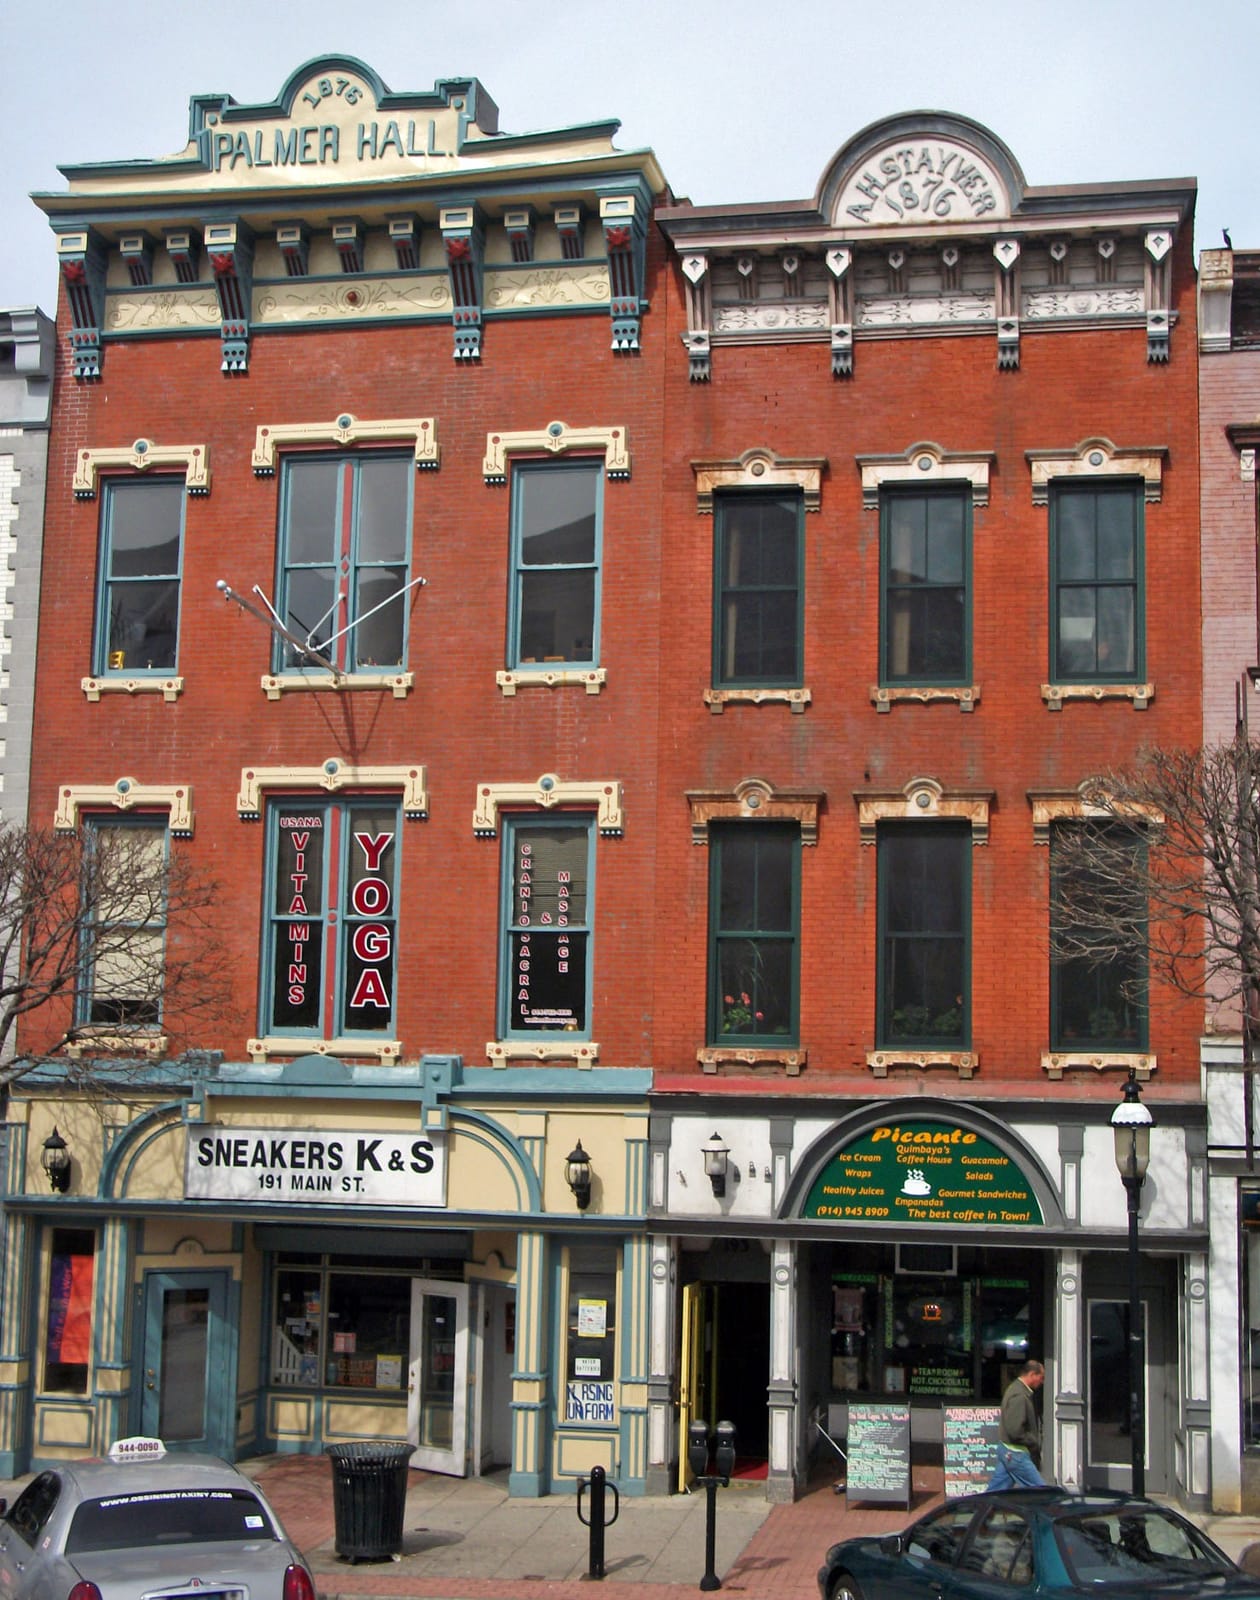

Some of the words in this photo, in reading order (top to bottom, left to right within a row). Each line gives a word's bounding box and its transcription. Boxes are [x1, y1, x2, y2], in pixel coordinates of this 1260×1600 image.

[303, 77, 363, 108] 1876
[214, 124, 340, 172] PALMER
[885, 177, 956, 219] 1876
[280, 817, 322, 828] USANA
[288, 832, 310, 1005] VITAMINS
[350, 832, 395, 1008] YOGA
[541, 912, 552, 924] &
[558, 871, 571, 973] MASSAGE
[872, 1127, 977, 1144] Picante
[198, 1137, 343, 1171] SNEAKERS
[357, 1139, 383, 1172] K
[388, 1150, 405, 1172] &
[411, 1141, 434, 1173] S
[896, 1145, 950, 1155] Quimbaya's
[839, 1153, 852, 1162] Ice
[854, 1153, 881, 1162] Cream
[896, 1155, 925, 1164] Coffee
[927, 1156, 953, 1164] House
[961, 1156, 1008, 1165] Guacamole
[845, 1168, 872, 1178] Wraps
[966, 1171, 993, 1181] Salads
[258, 1174, 283, 1189] 191
[291, 1175, 332, 1191] MAIN
[342, 1177, 366, 1193] ST.
[823, 1186, 856, 1196] Healthy
[858, 1186, 885, 1195] Juices
[938, 1189, 975, 1198] Gourmet
[977, 1190, 1027, 1199] Sandwiches
[895, 1198, 944, 1207] Empanadas
[817, 1206, 842, 1216] (914)
[845, 1207, 862, 1216] 945
[865, 1207, 889, 1216] 8909
[908, 1208, 926, 1218] The
[929, 1209, 950, 1219] best
[953, 1210, 984, 1221] coffee
[987, 1210, 997, 1219] in
[1000, 1211, 1030, 1220] Town!
[119, 1442, 159, 1453] 944-0090
